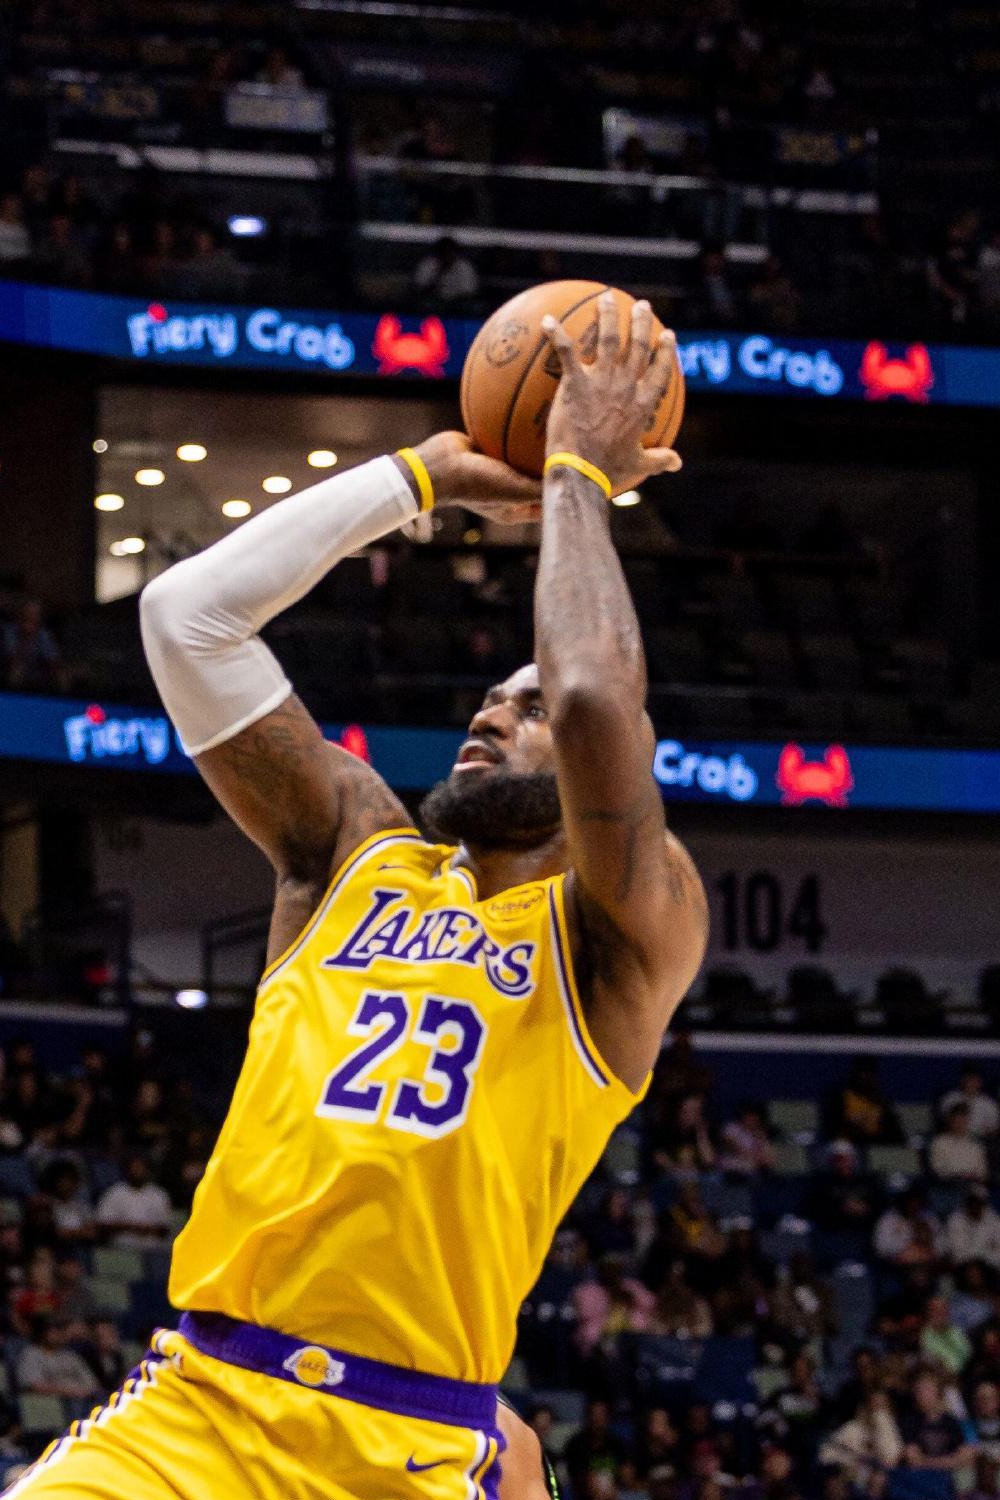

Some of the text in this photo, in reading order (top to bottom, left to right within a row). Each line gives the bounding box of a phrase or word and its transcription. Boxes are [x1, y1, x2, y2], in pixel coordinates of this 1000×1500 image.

[127, 303, 238, 358] Fiery
[64, 704, 169, 765] Fiery
[321, 889, 537, 998] LAKERS
[717, 869, 827, 953] 104
[314, 989, 489, 1141] 23
